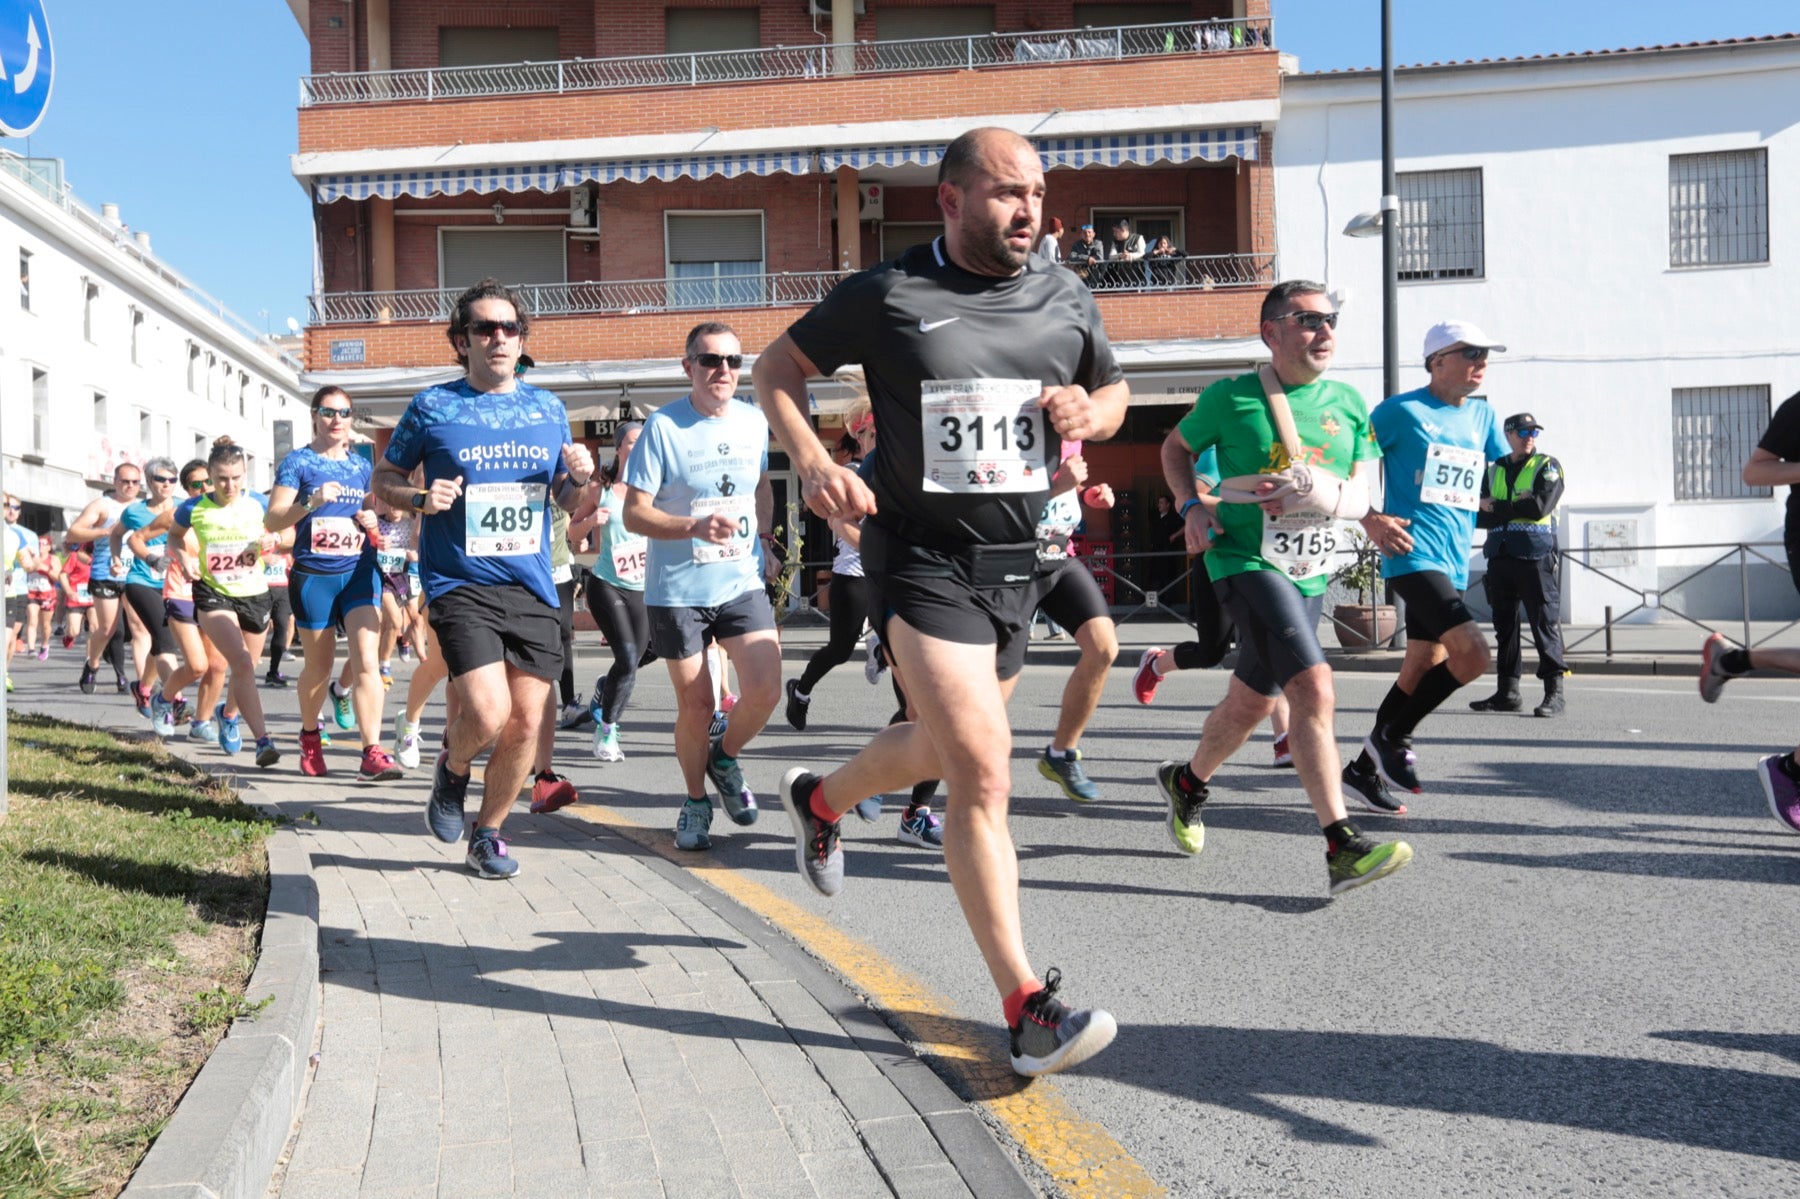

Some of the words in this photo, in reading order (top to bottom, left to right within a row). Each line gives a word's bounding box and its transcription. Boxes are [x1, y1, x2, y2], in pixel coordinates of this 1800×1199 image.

[940, 416, 1035, 452] 3113
[459, 440, 549, 463] agustinos
[476, 460, 537, 471] GRANADA
[1436, 464, 1474, 490] 576
[481, 507, 533, 532] 489
[316, 532, 361, 549] 2241
[1273, 532, 1336, 556] 3155
[210, 553, 256, 571] 2243
[381, 555, 401, 566] 839
